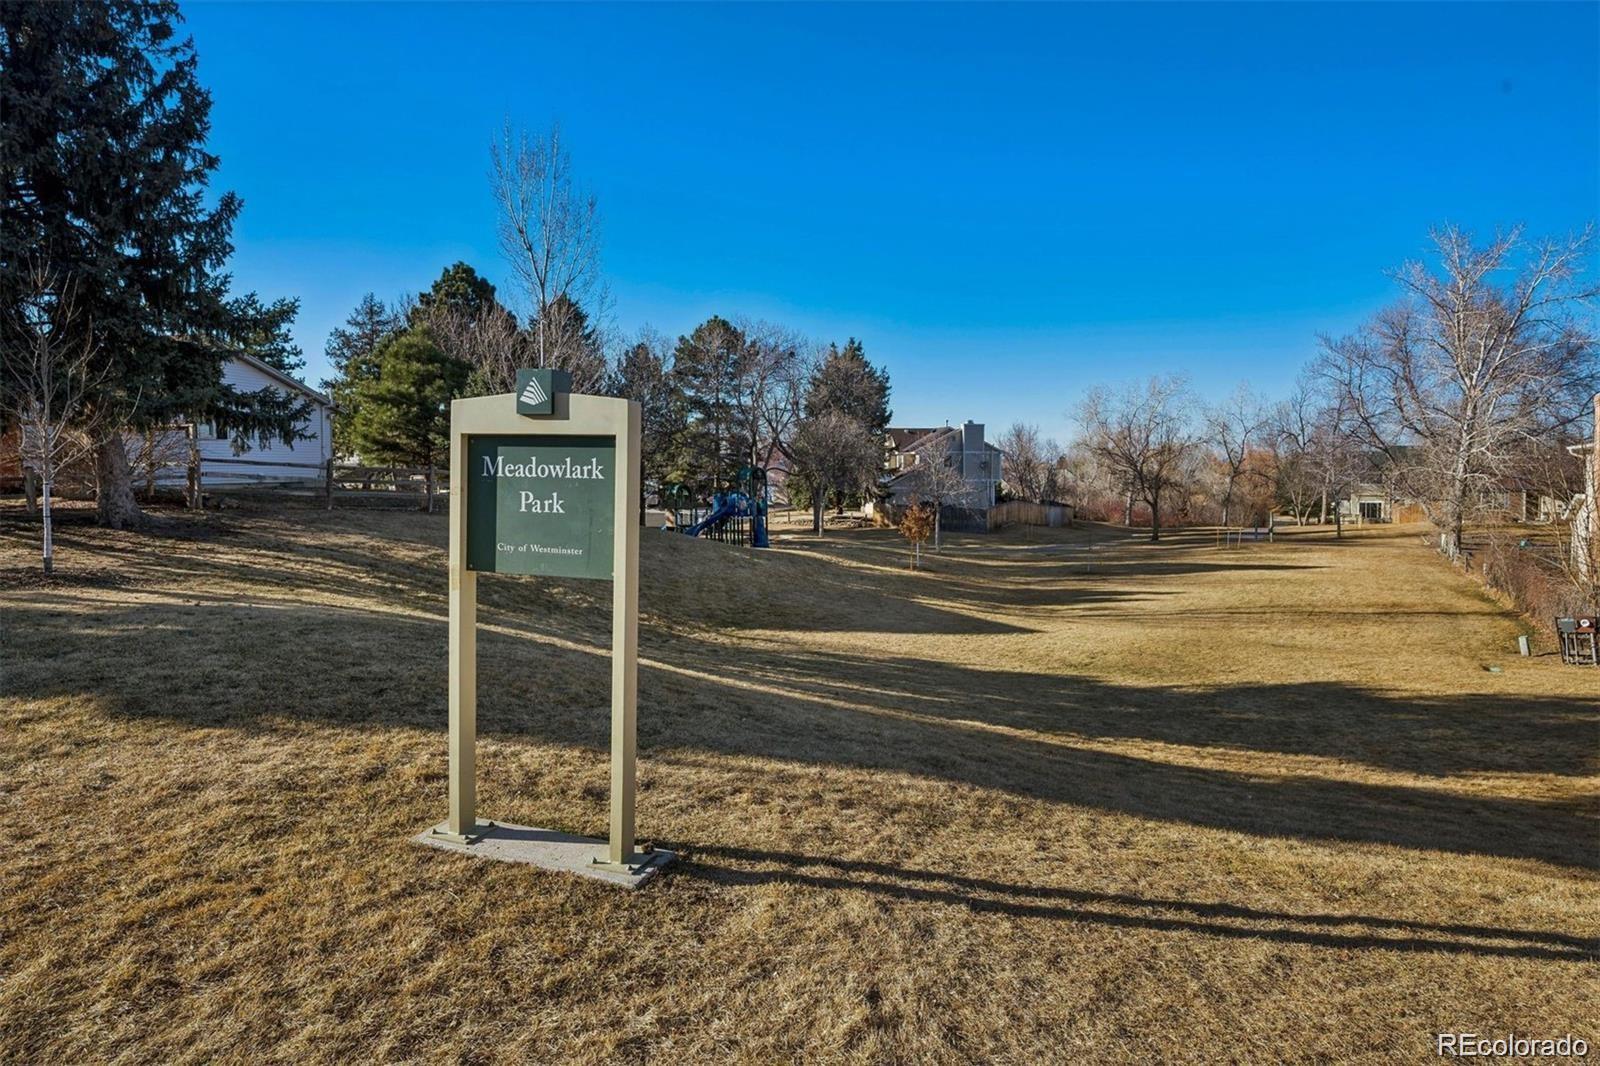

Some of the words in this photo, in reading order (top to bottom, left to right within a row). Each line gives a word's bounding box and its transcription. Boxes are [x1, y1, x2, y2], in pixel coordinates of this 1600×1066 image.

[482, 456, 604, 480] Meadowlark
[519, 491, 565, 514] Park
[497, 543, 515, 554] City
[518, 543, 528, 552] of
[530, 544, 583, 555] Westminster
